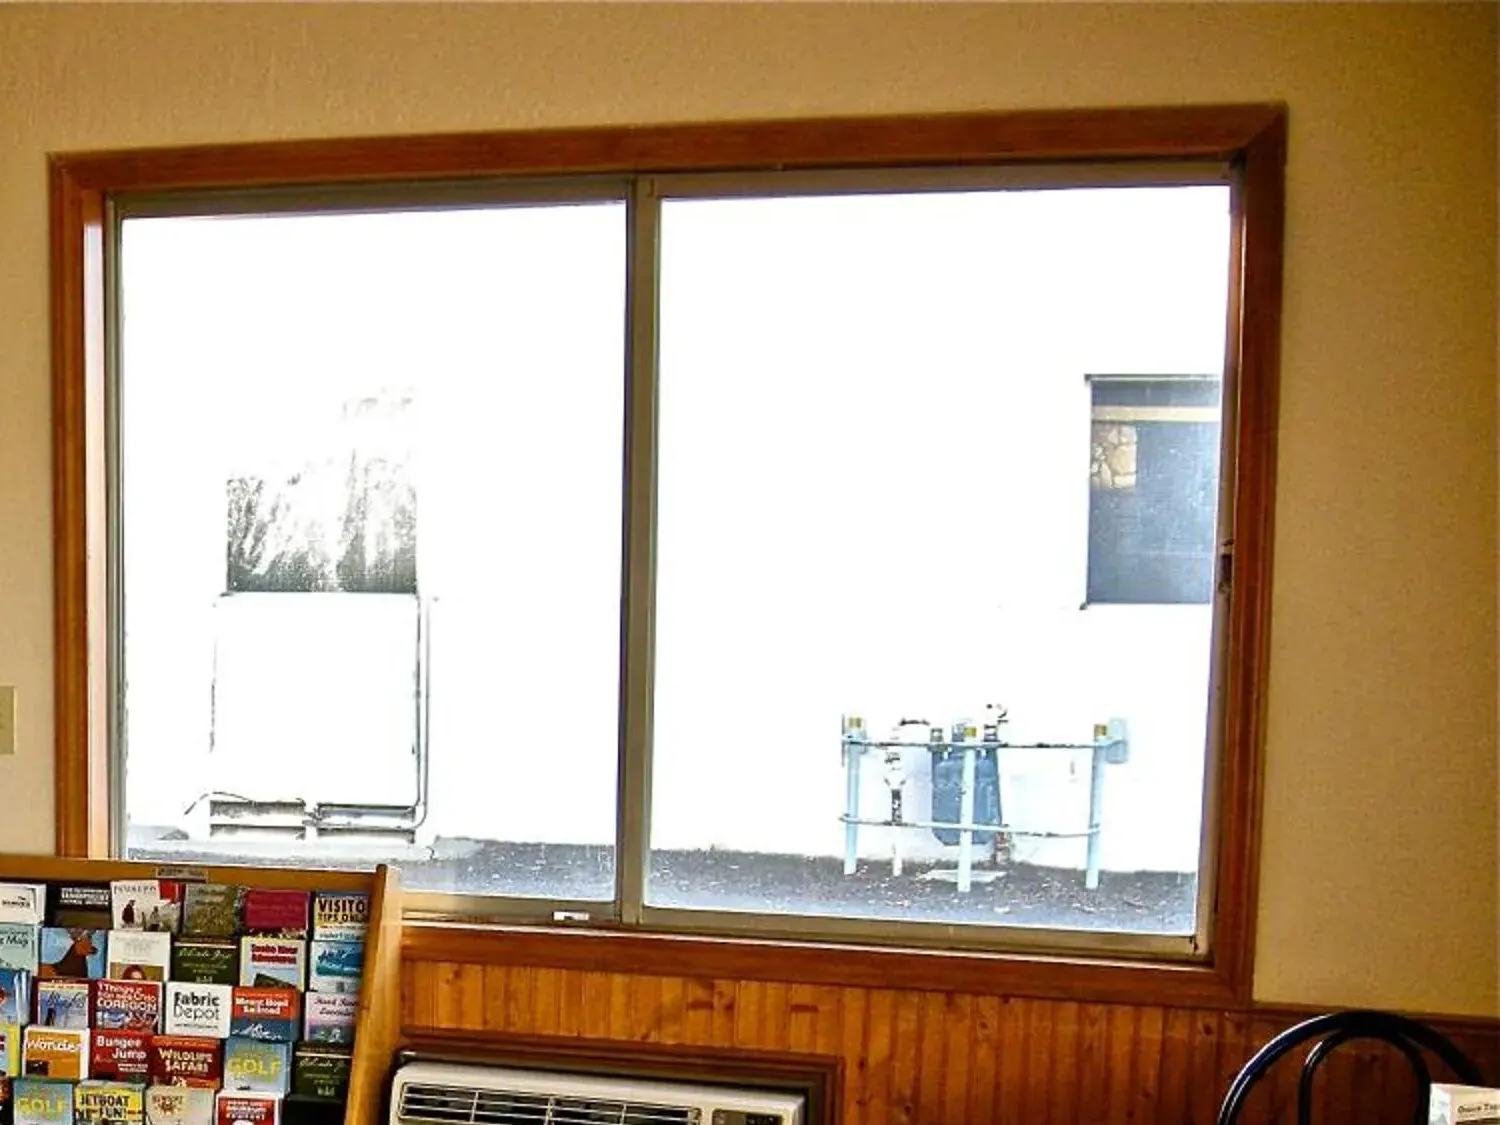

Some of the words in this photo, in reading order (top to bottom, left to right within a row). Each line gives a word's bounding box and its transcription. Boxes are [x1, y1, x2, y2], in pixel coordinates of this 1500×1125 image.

[174, 992, 220, 1007] Fabric
[174, 1006, 220, 1021] Depot
[97, 1035, 142, 1048] Bungee
[111, 1047, 147, 1060] Jump
[227, 1055, 282, 1075] GOLF
[17, 1096, 69, 1114] GOLF
[80, 1092, 130, 1106] JETBOAT
